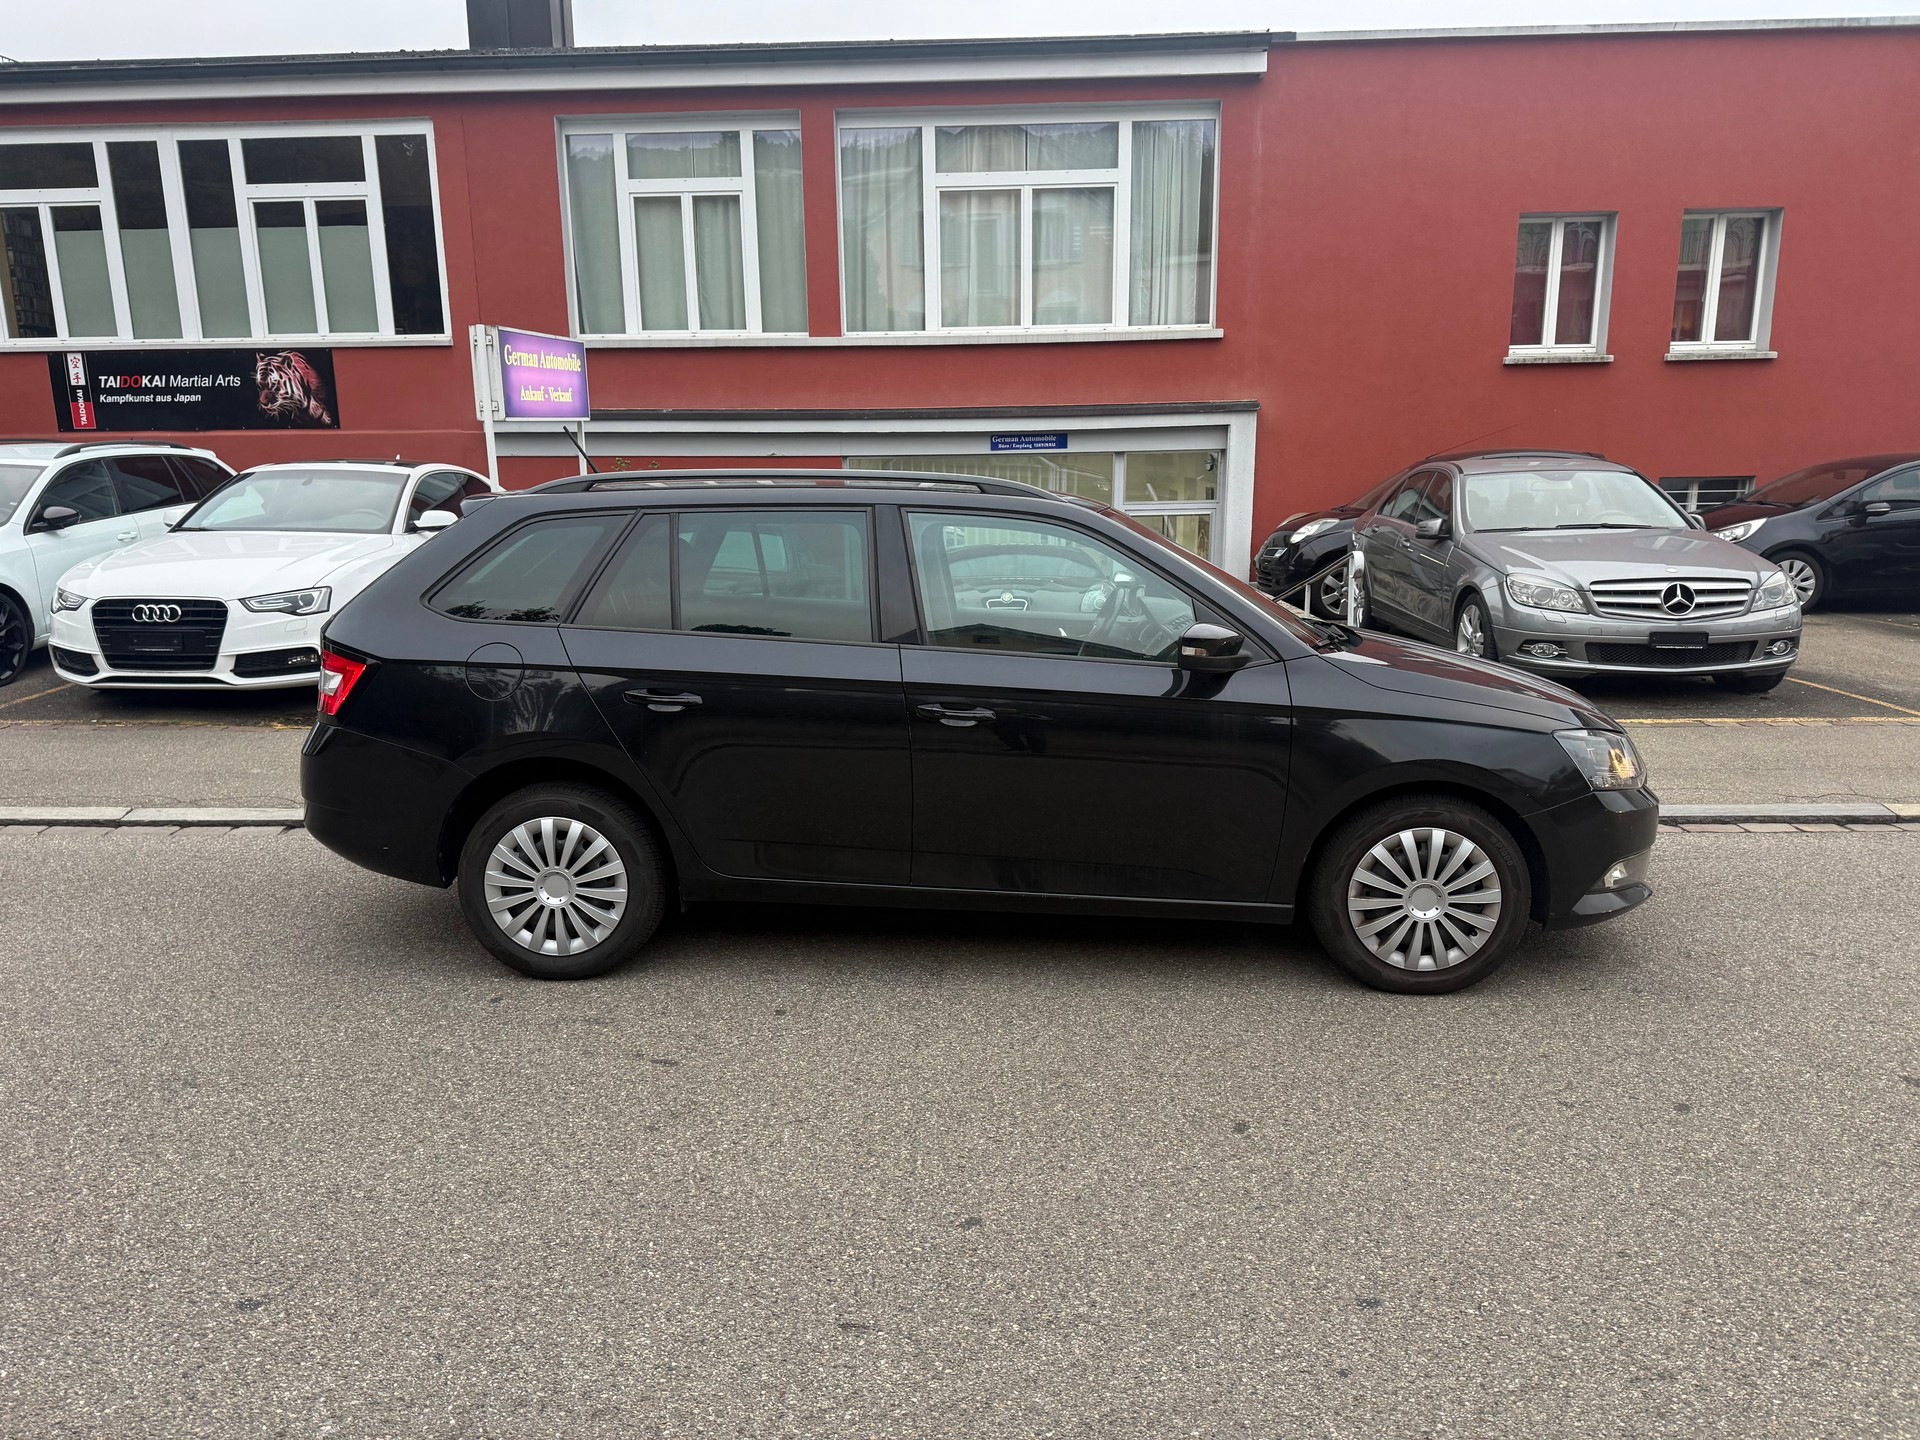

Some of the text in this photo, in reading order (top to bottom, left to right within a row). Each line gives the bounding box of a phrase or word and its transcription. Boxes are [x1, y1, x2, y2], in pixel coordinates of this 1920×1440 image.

[504, 344, 581, 372] German Automobile
[99, 374, 241, 388] TAIDOKAI Martial Arts
[99, 394, 154, 404] Kampfkunst
[173, 393, 202, 403] Japan
[521, 385, 545, 402] Ankauf
[548, 386, 573, 403] Verkauf
[76, 389, 88, 426] TAIDOKAI
